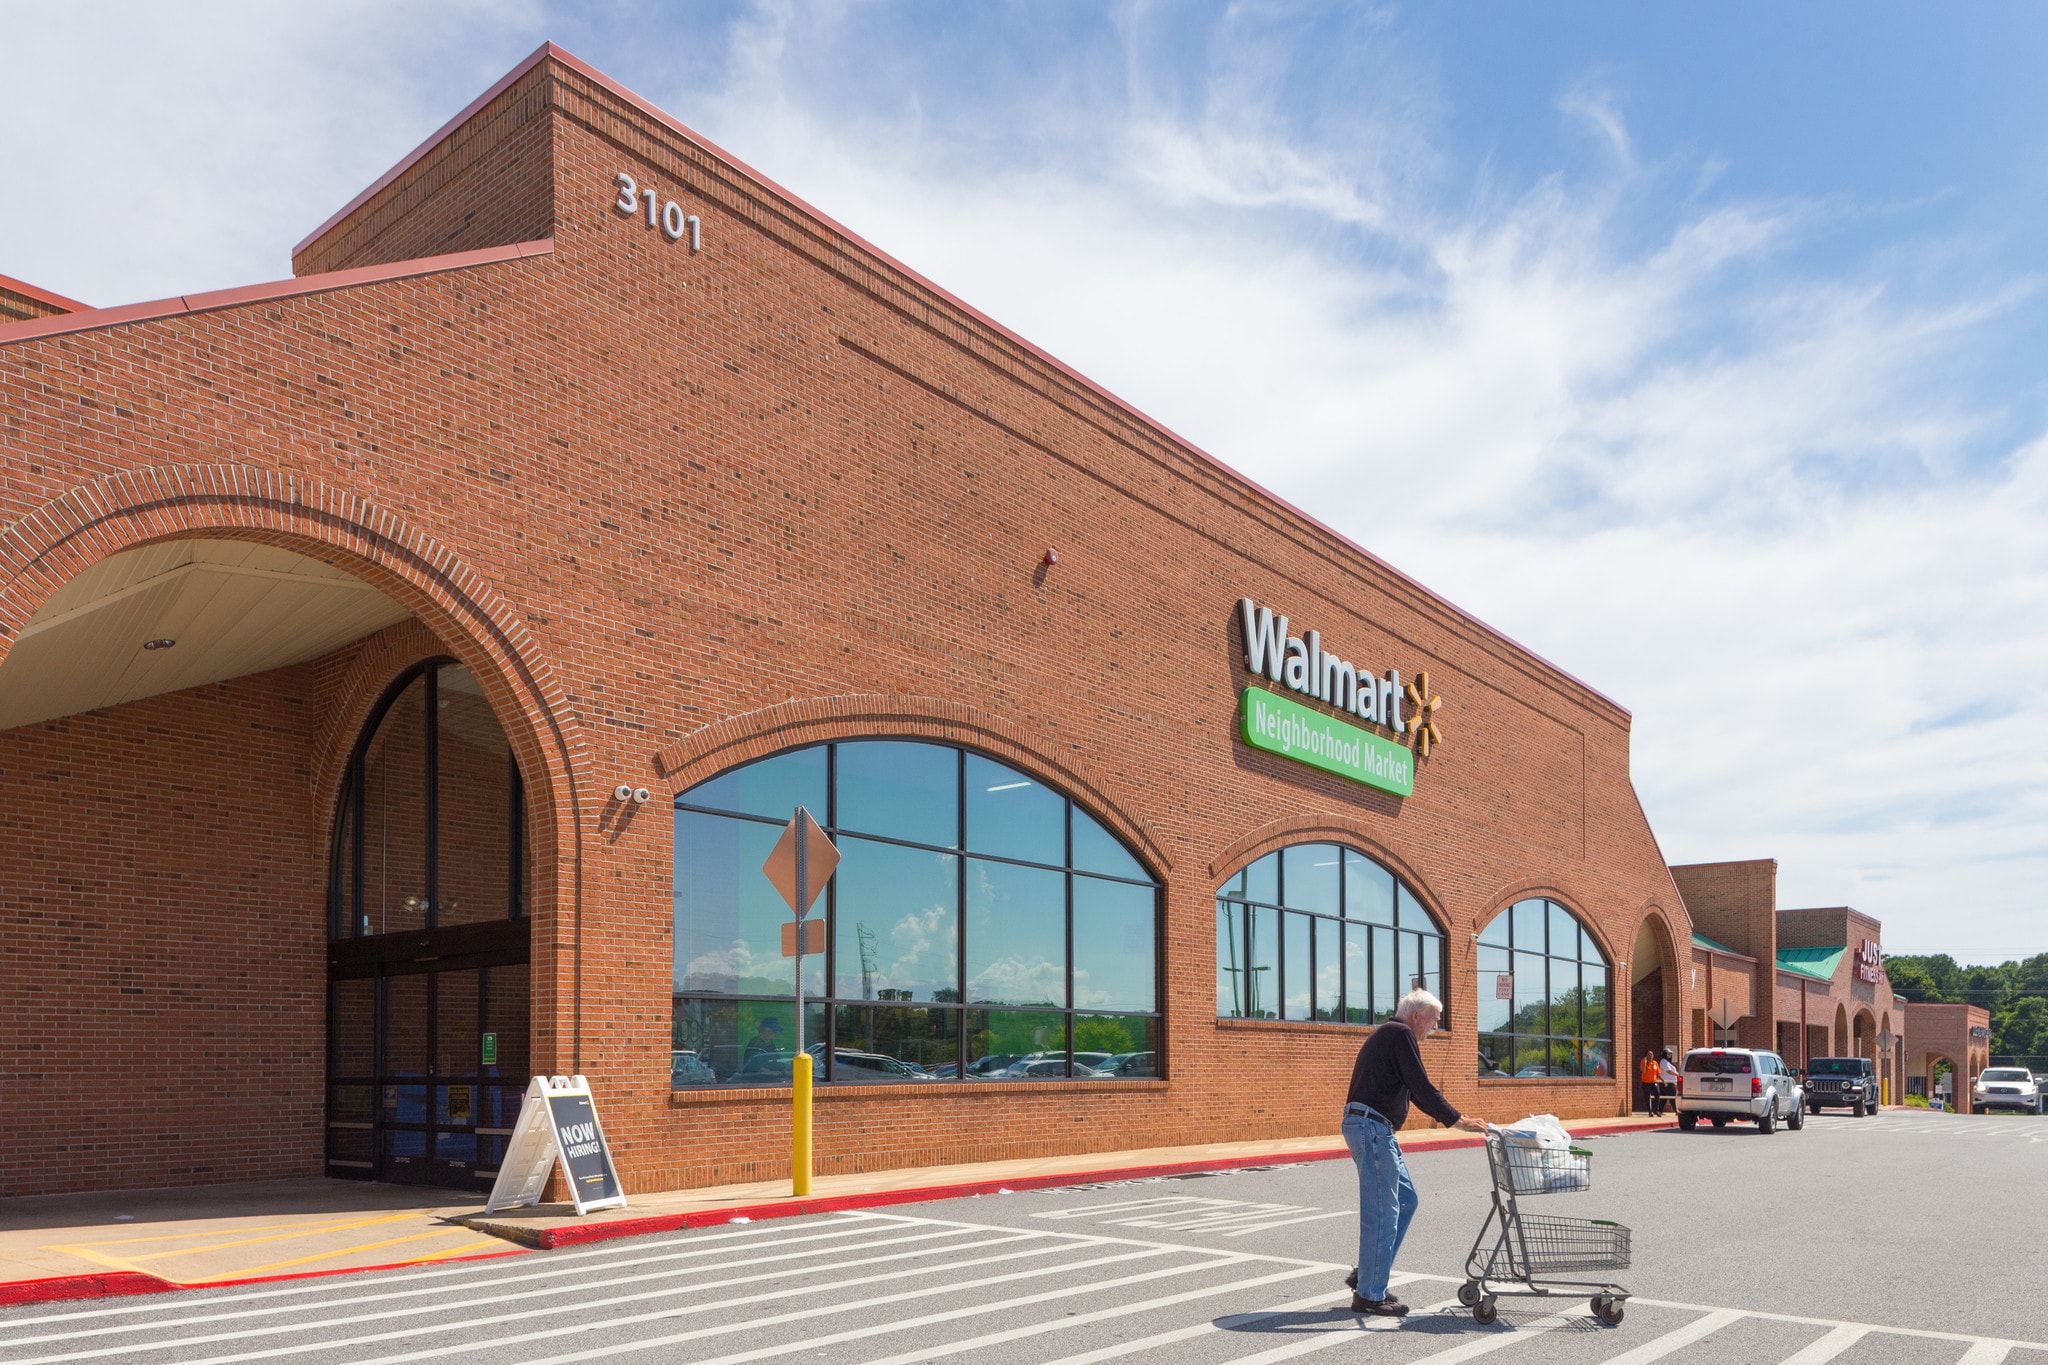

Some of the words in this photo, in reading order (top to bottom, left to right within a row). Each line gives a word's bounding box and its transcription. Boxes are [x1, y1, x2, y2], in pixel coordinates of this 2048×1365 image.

[616, 172, 700, 251] 3101
[1239, 597, 1404, 733] Walmart
[1255, 700, 1360, 769] Neighborhood
[1363, 742, 1408, 786] Market
[560, 1122, 595, 1145] NOW
[567, 1141, 601, 1159] HIRING!
